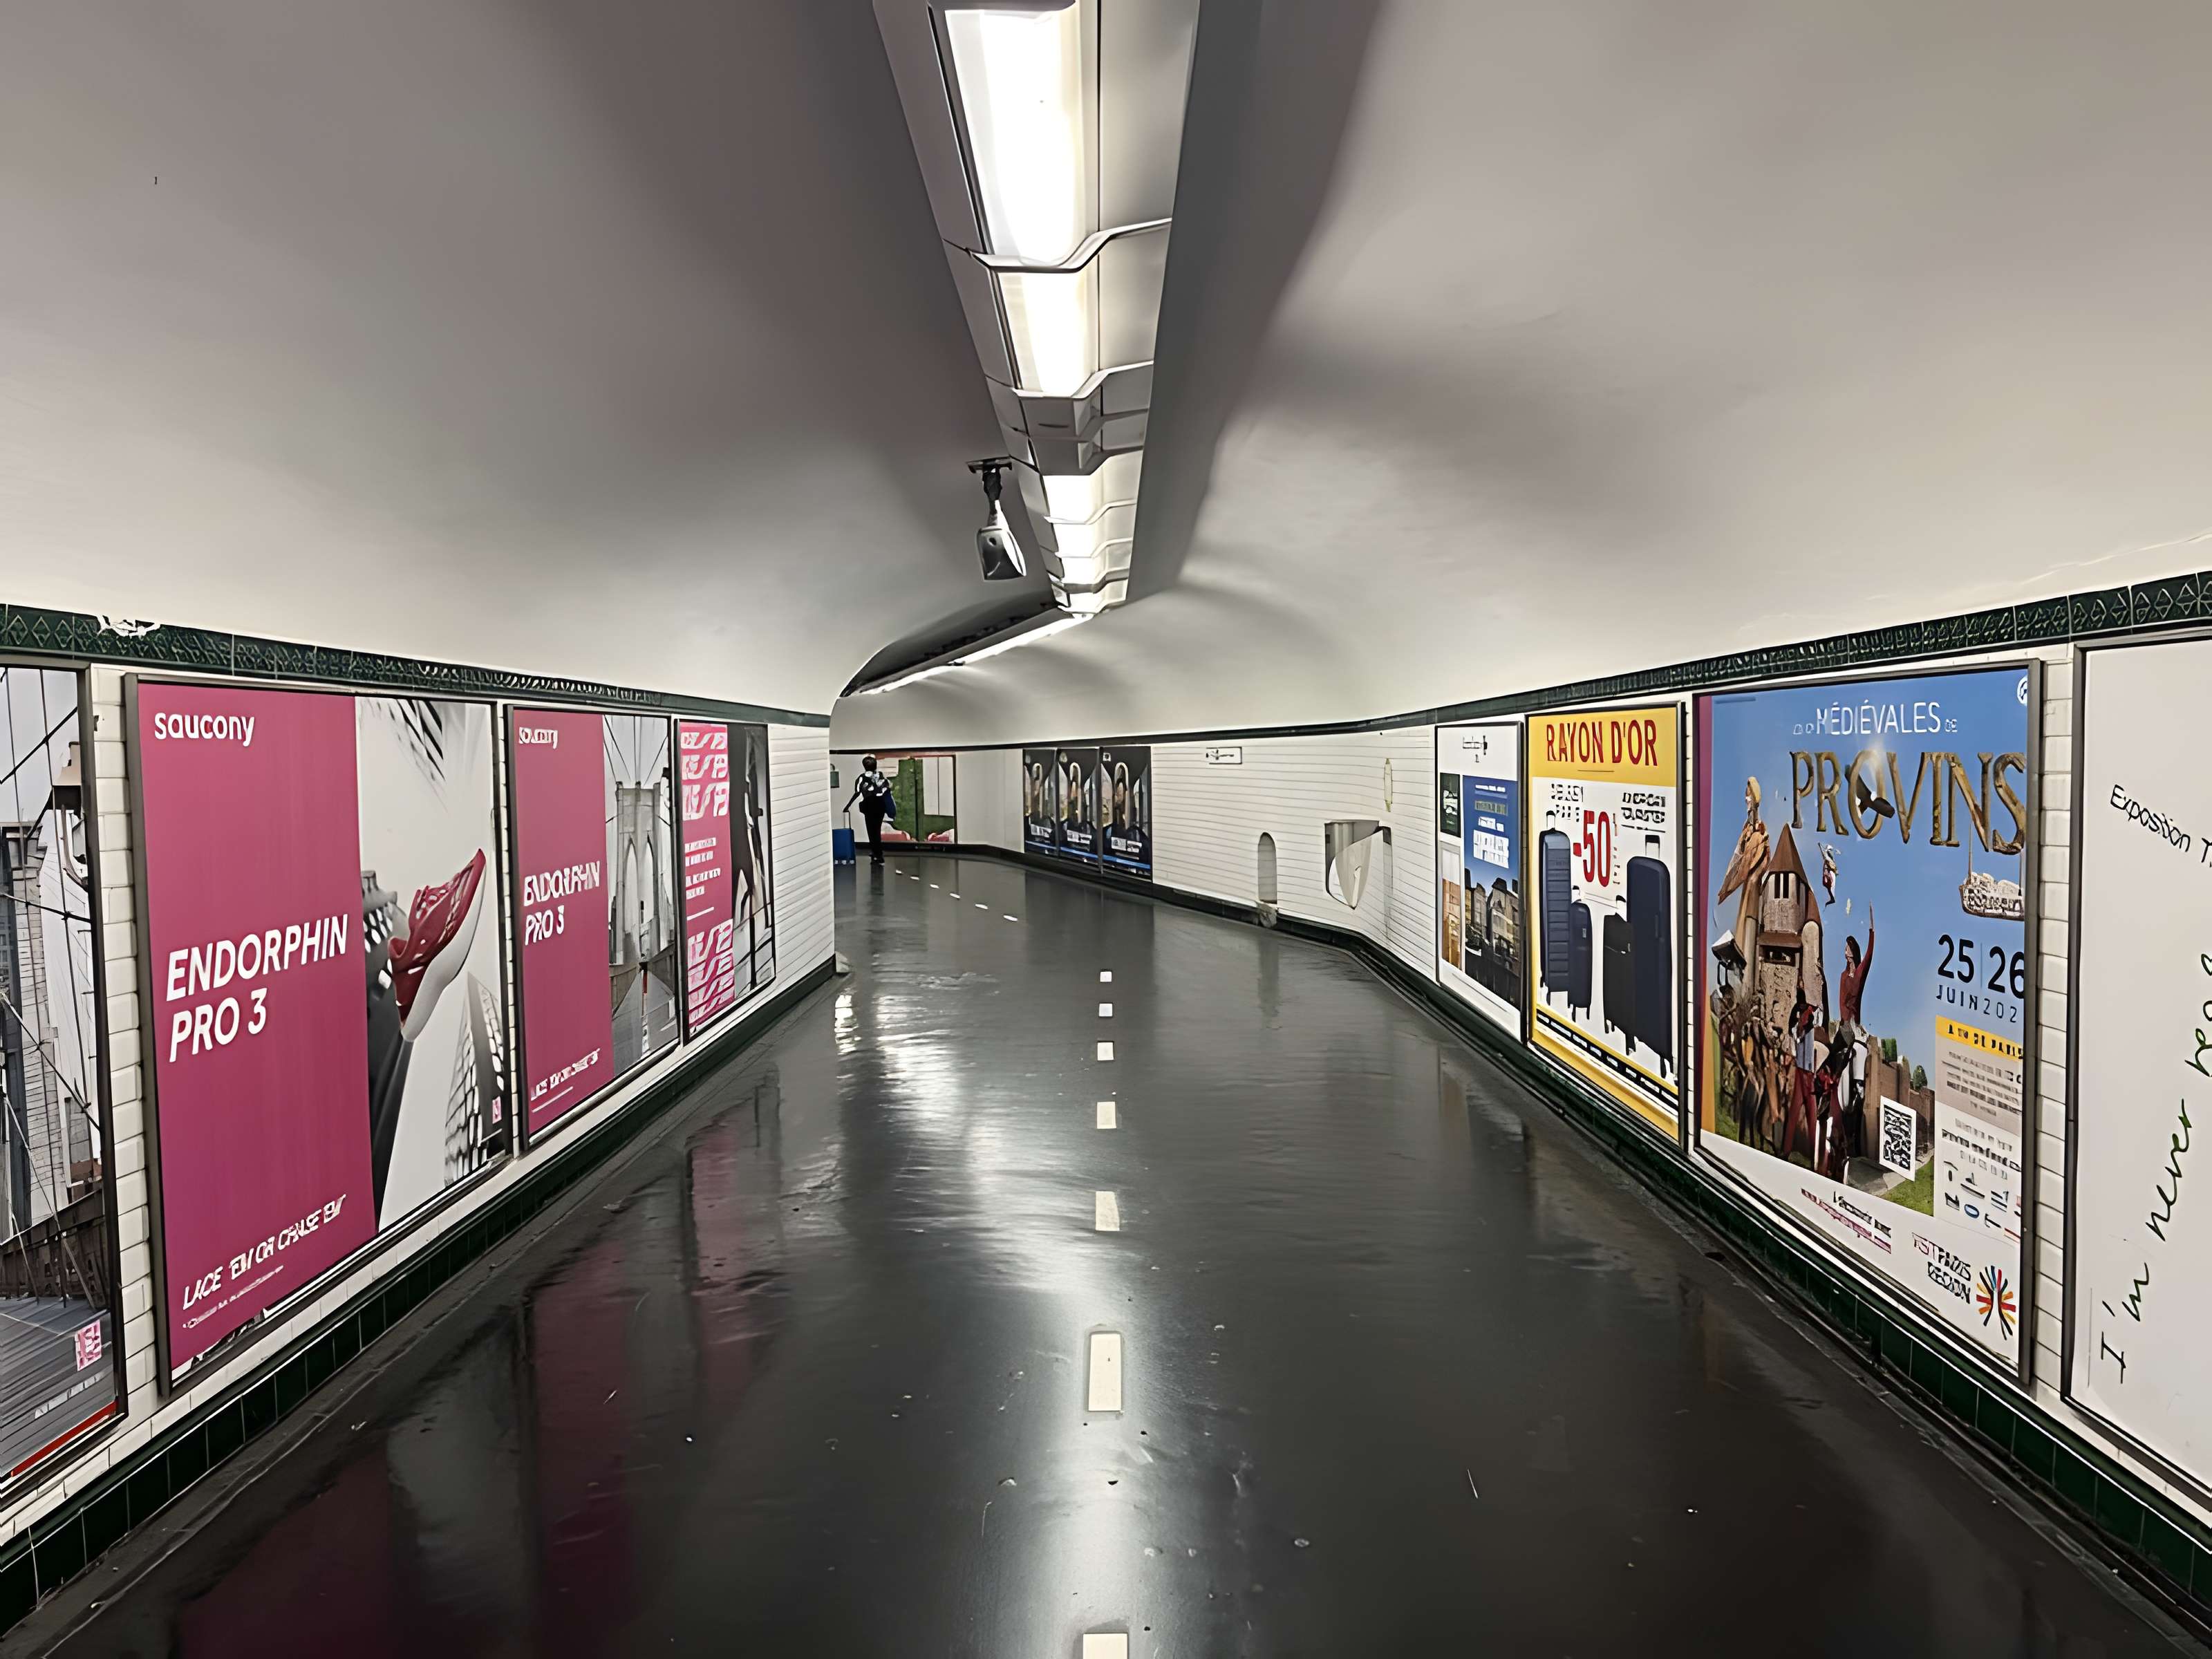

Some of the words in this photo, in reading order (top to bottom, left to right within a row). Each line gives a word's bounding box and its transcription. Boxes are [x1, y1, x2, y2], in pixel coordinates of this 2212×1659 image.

[154, 712, 255, 747] saucony
[1546, 721, 1604, 764] RAYON
[1611, 719, 1658, 766] D'OR
[1789, 750, 2027, 855] PROVINS
[166, 913, 348, 1002] ENDORPHIN
[1938, 934, 1974, 983] 25
[1987, 946, 2024, 1000] 26
[169, 997, 240, 1062] PRO
[247, 987, 268, 1035] 3
[1936, 984, 1978, 1011] JUIN
[2145, 1098, 2193, 1243] never
